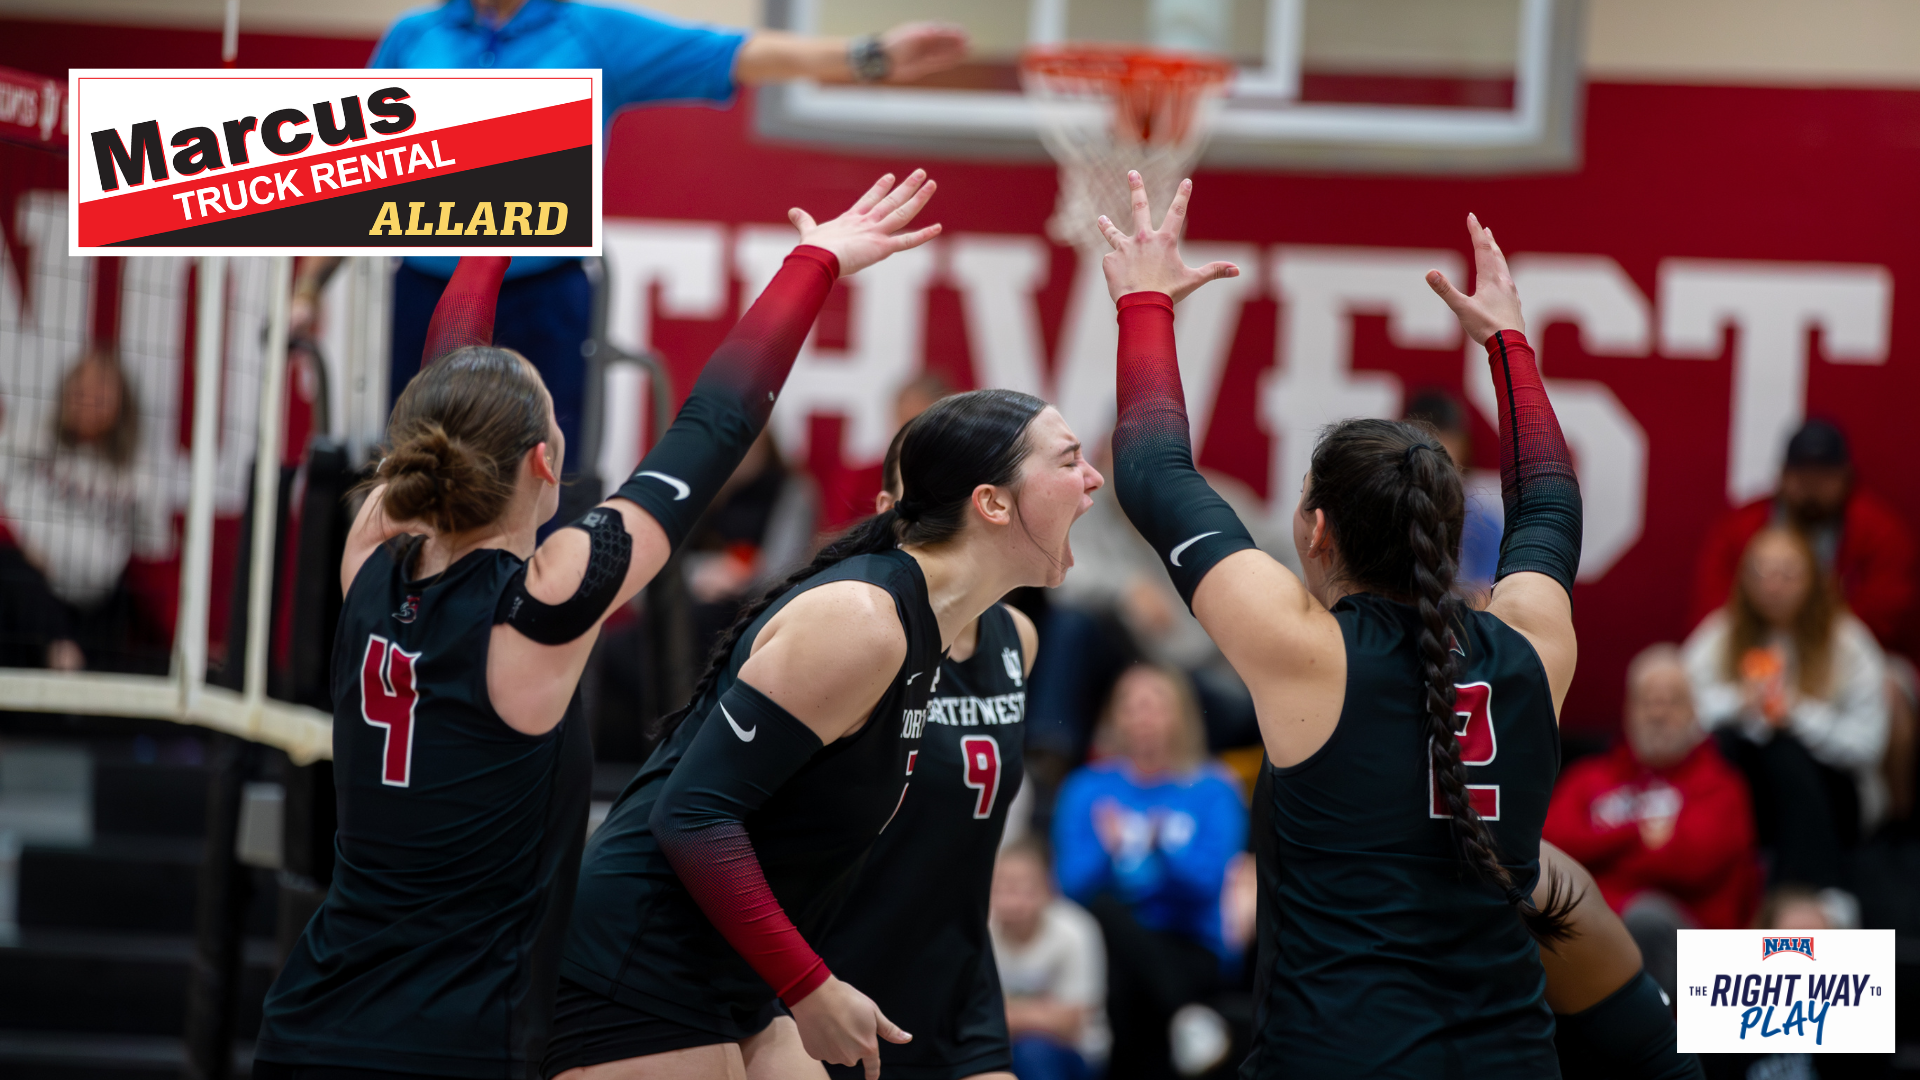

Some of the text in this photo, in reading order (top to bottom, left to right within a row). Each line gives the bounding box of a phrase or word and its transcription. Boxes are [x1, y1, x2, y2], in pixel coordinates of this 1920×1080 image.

[361, 633, 422, 788] 4
[960, 734, 1002, 819] 9
[1426, 680, 1500, 822] 2
